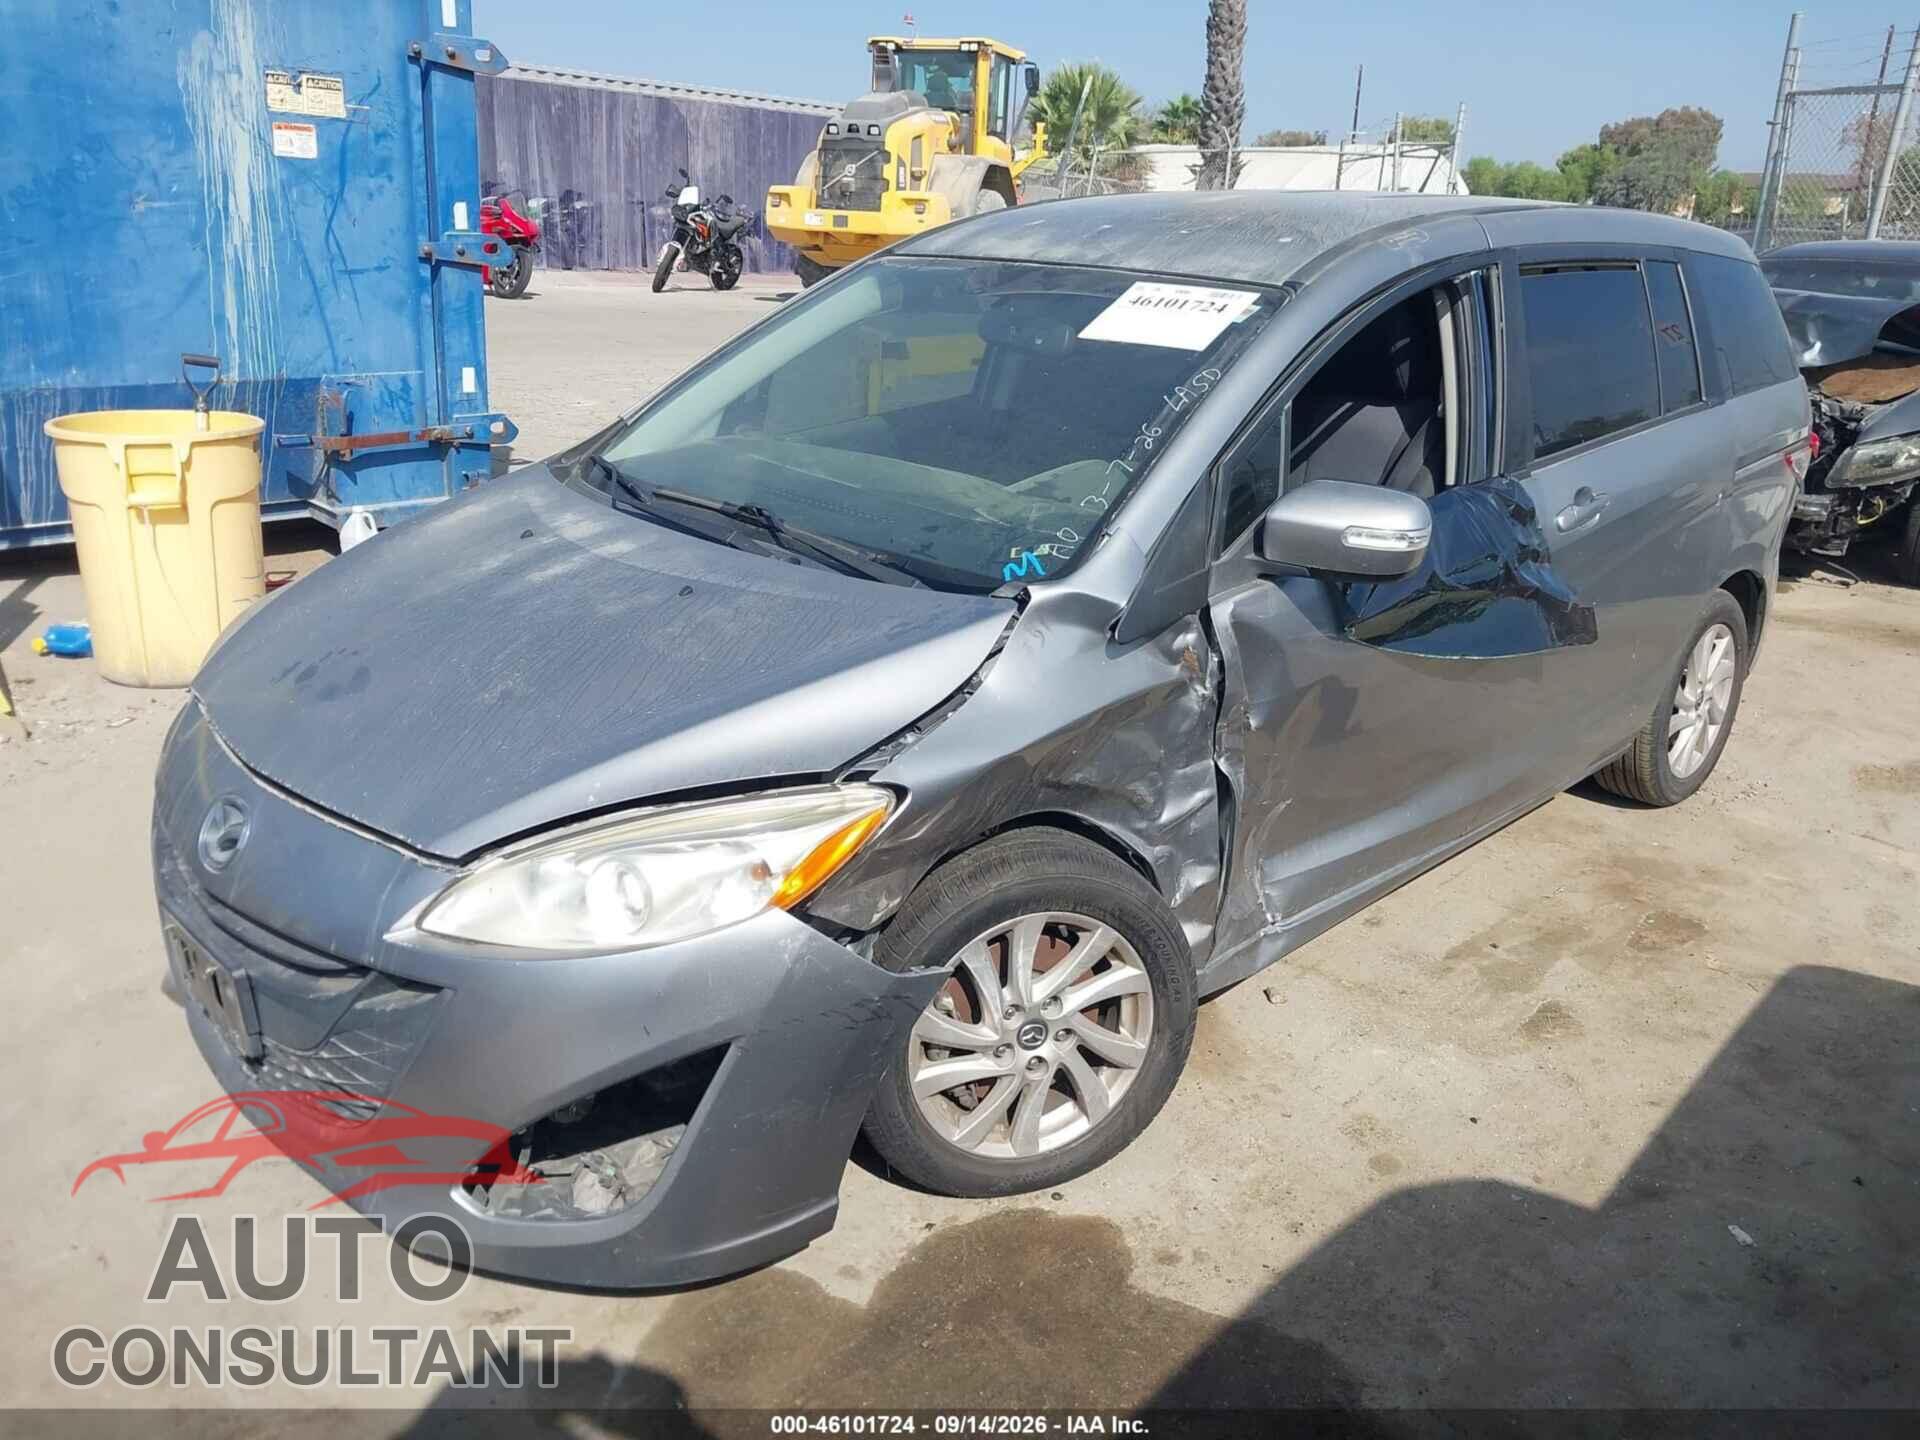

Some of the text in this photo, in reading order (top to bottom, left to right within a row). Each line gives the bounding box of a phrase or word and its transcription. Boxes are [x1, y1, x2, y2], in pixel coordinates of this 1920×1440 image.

[313, 79, 342, 90] CAUTION
[1128, 295, 1229, 313] 46101724
[1163, 368, 1221, 412] LASD
